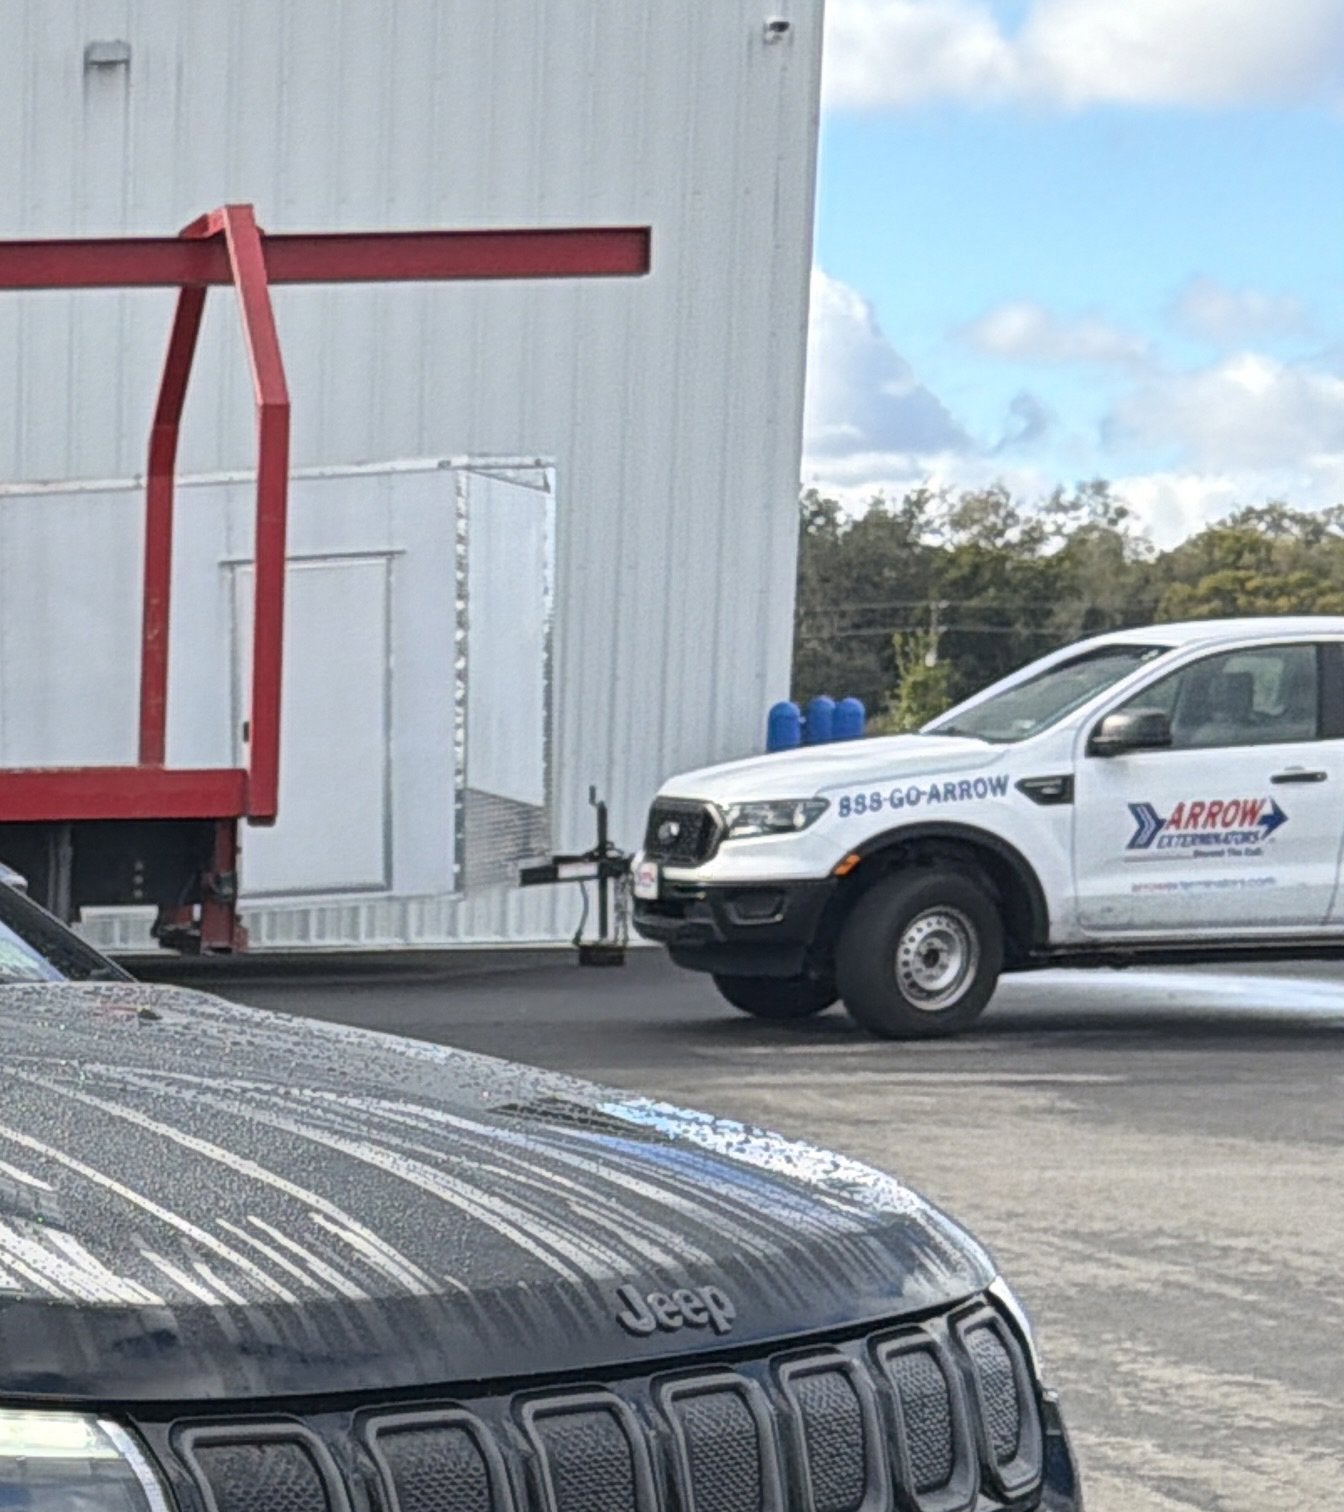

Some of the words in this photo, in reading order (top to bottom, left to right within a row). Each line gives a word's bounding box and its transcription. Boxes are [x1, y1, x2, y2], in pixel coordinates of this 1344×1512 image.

[838, 774, 1010, 818] 888-GO-ARROW
[1165, 799, 1267, 830] ARROW
[1157, 831, 1260, 848] EXTERMINATORS
[616, 1284, 737, 1336] Jeep
